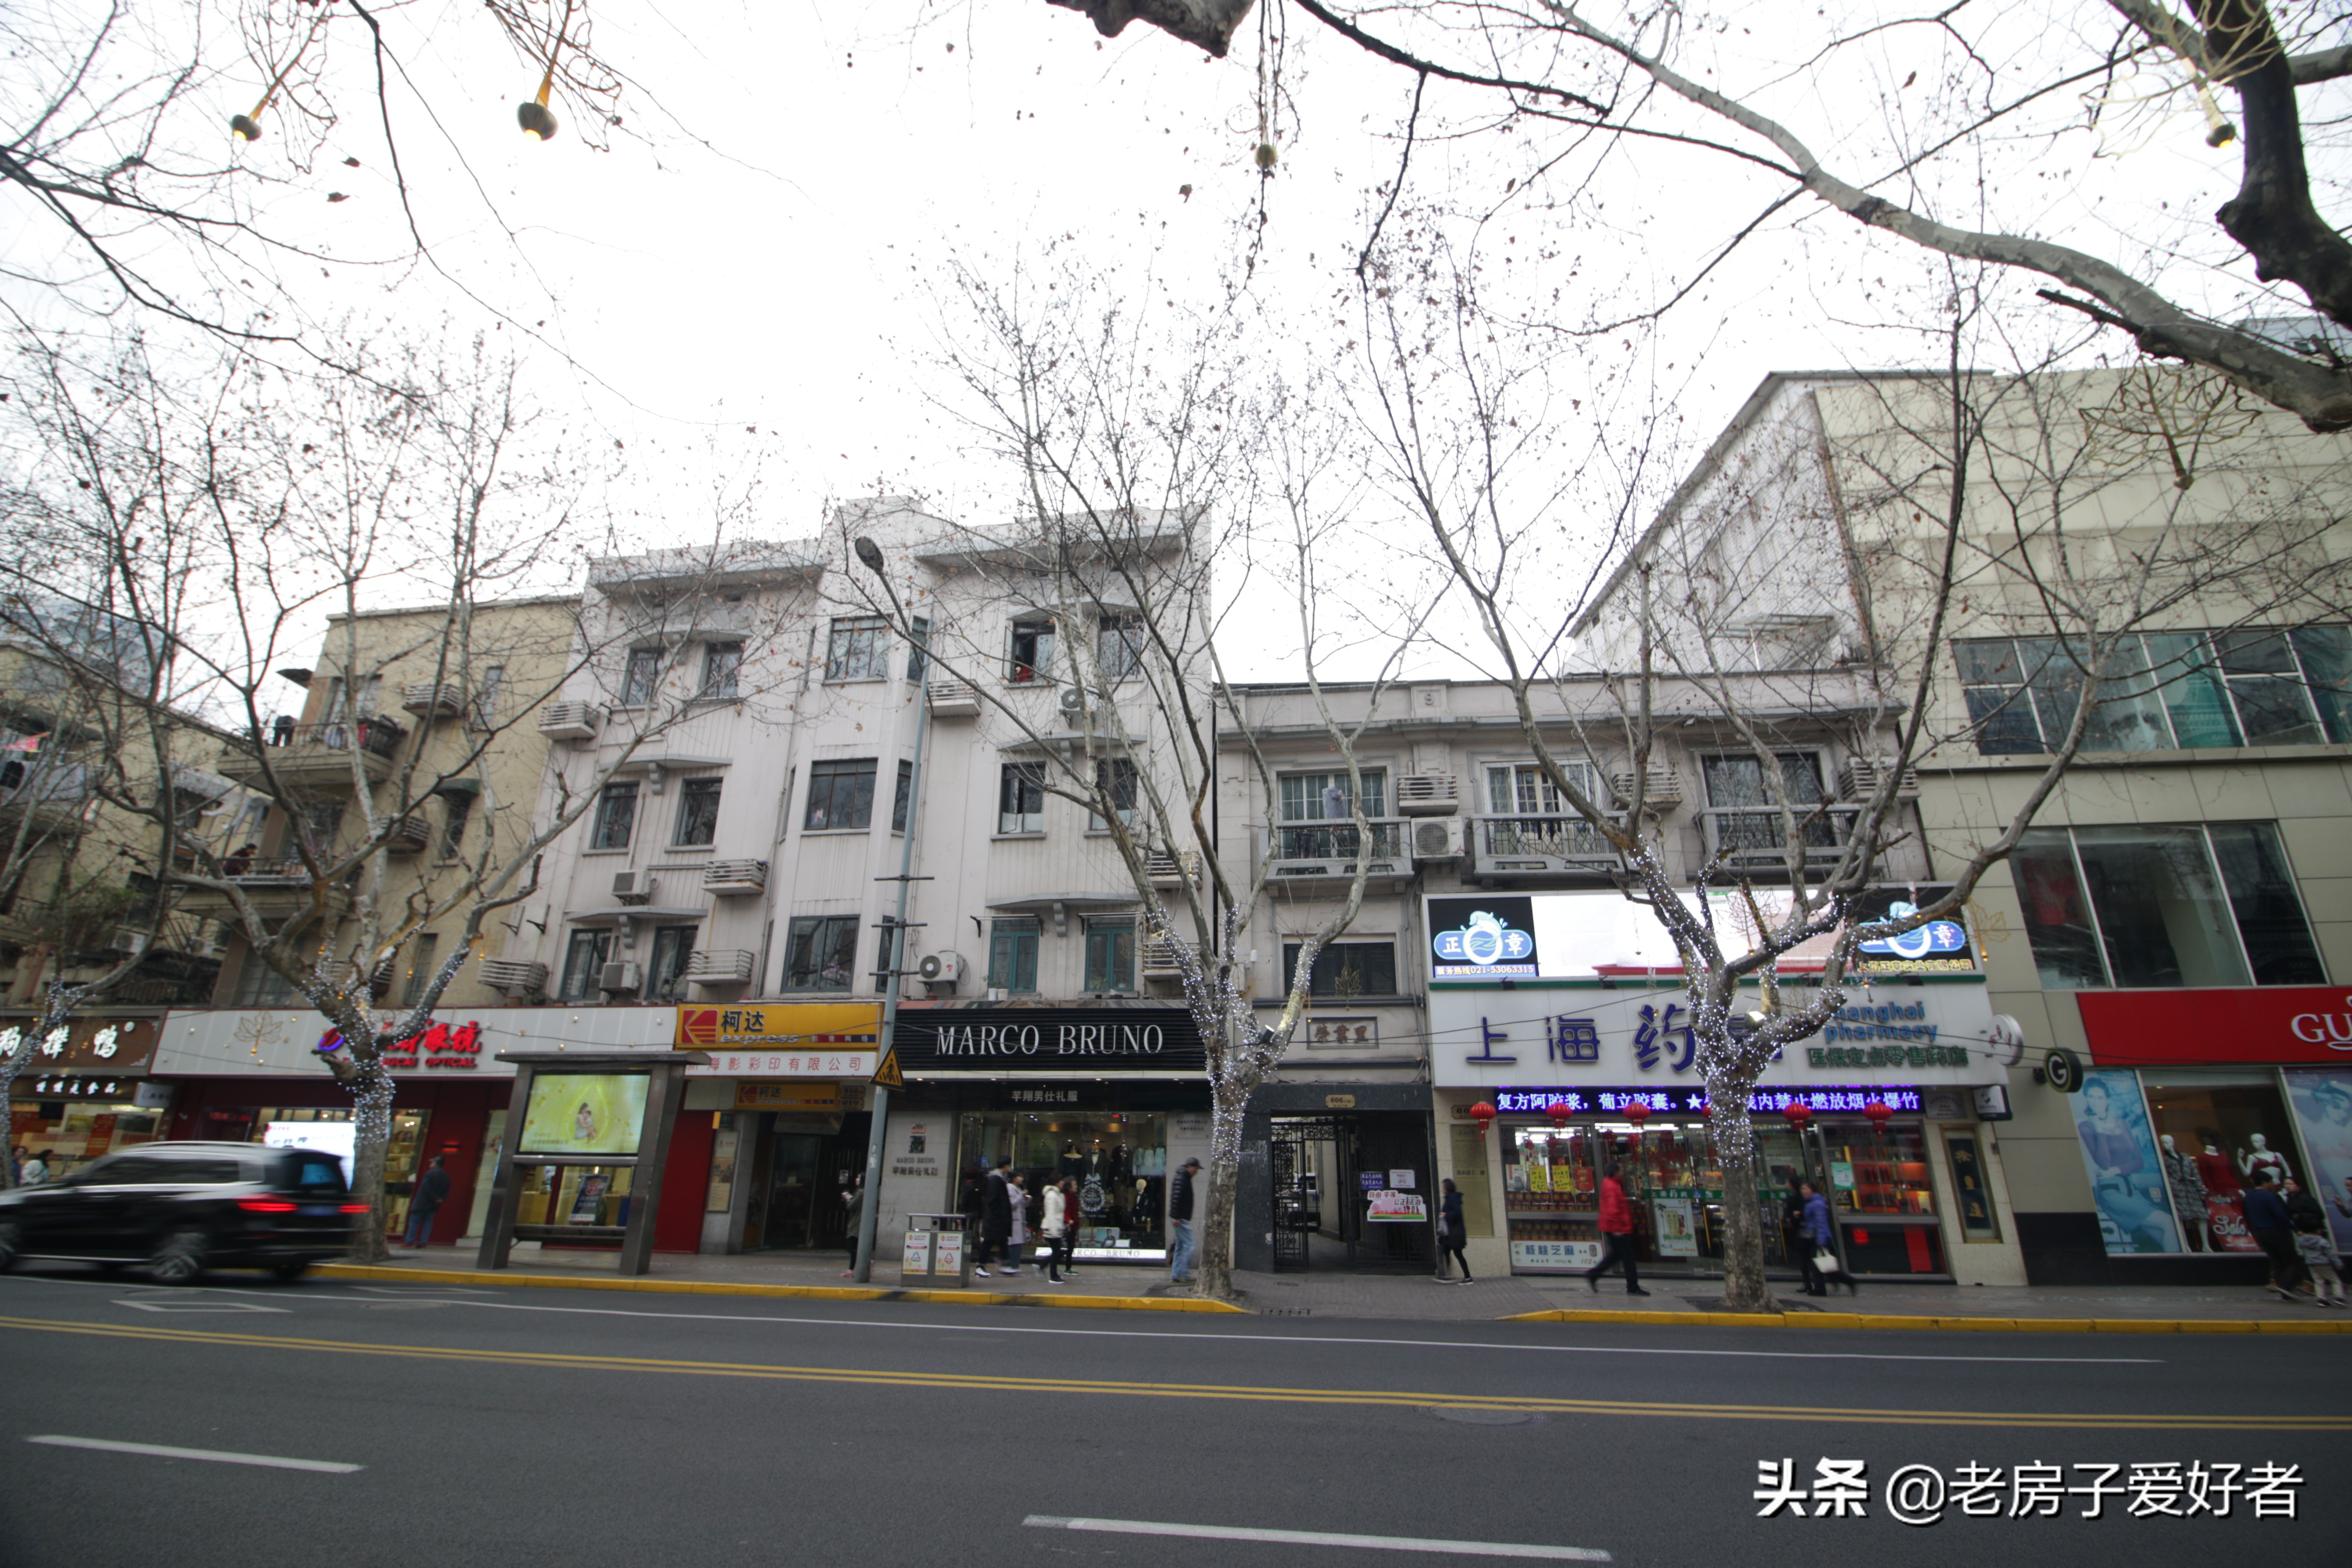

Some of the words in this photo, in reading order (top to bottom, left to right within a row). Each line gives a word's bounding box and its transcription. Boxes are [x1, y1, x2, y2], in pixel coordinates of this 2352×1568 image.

[1436, 965, 1534, 975] 服务热线021-53063315
[721, 1010, 765, 1032] 柯达
[720, 1035, 799, 1045] express
[936, 1025, 1039, 1055] MARCO
[1058, 1025, 1163, 1054] BRUNO
[1824, 1022, 1938, 1043] pharmacy
[1806, 1046, 1969, 1066] 医保定点零售药店
[759, 1086, 781, 1097] 柯达
